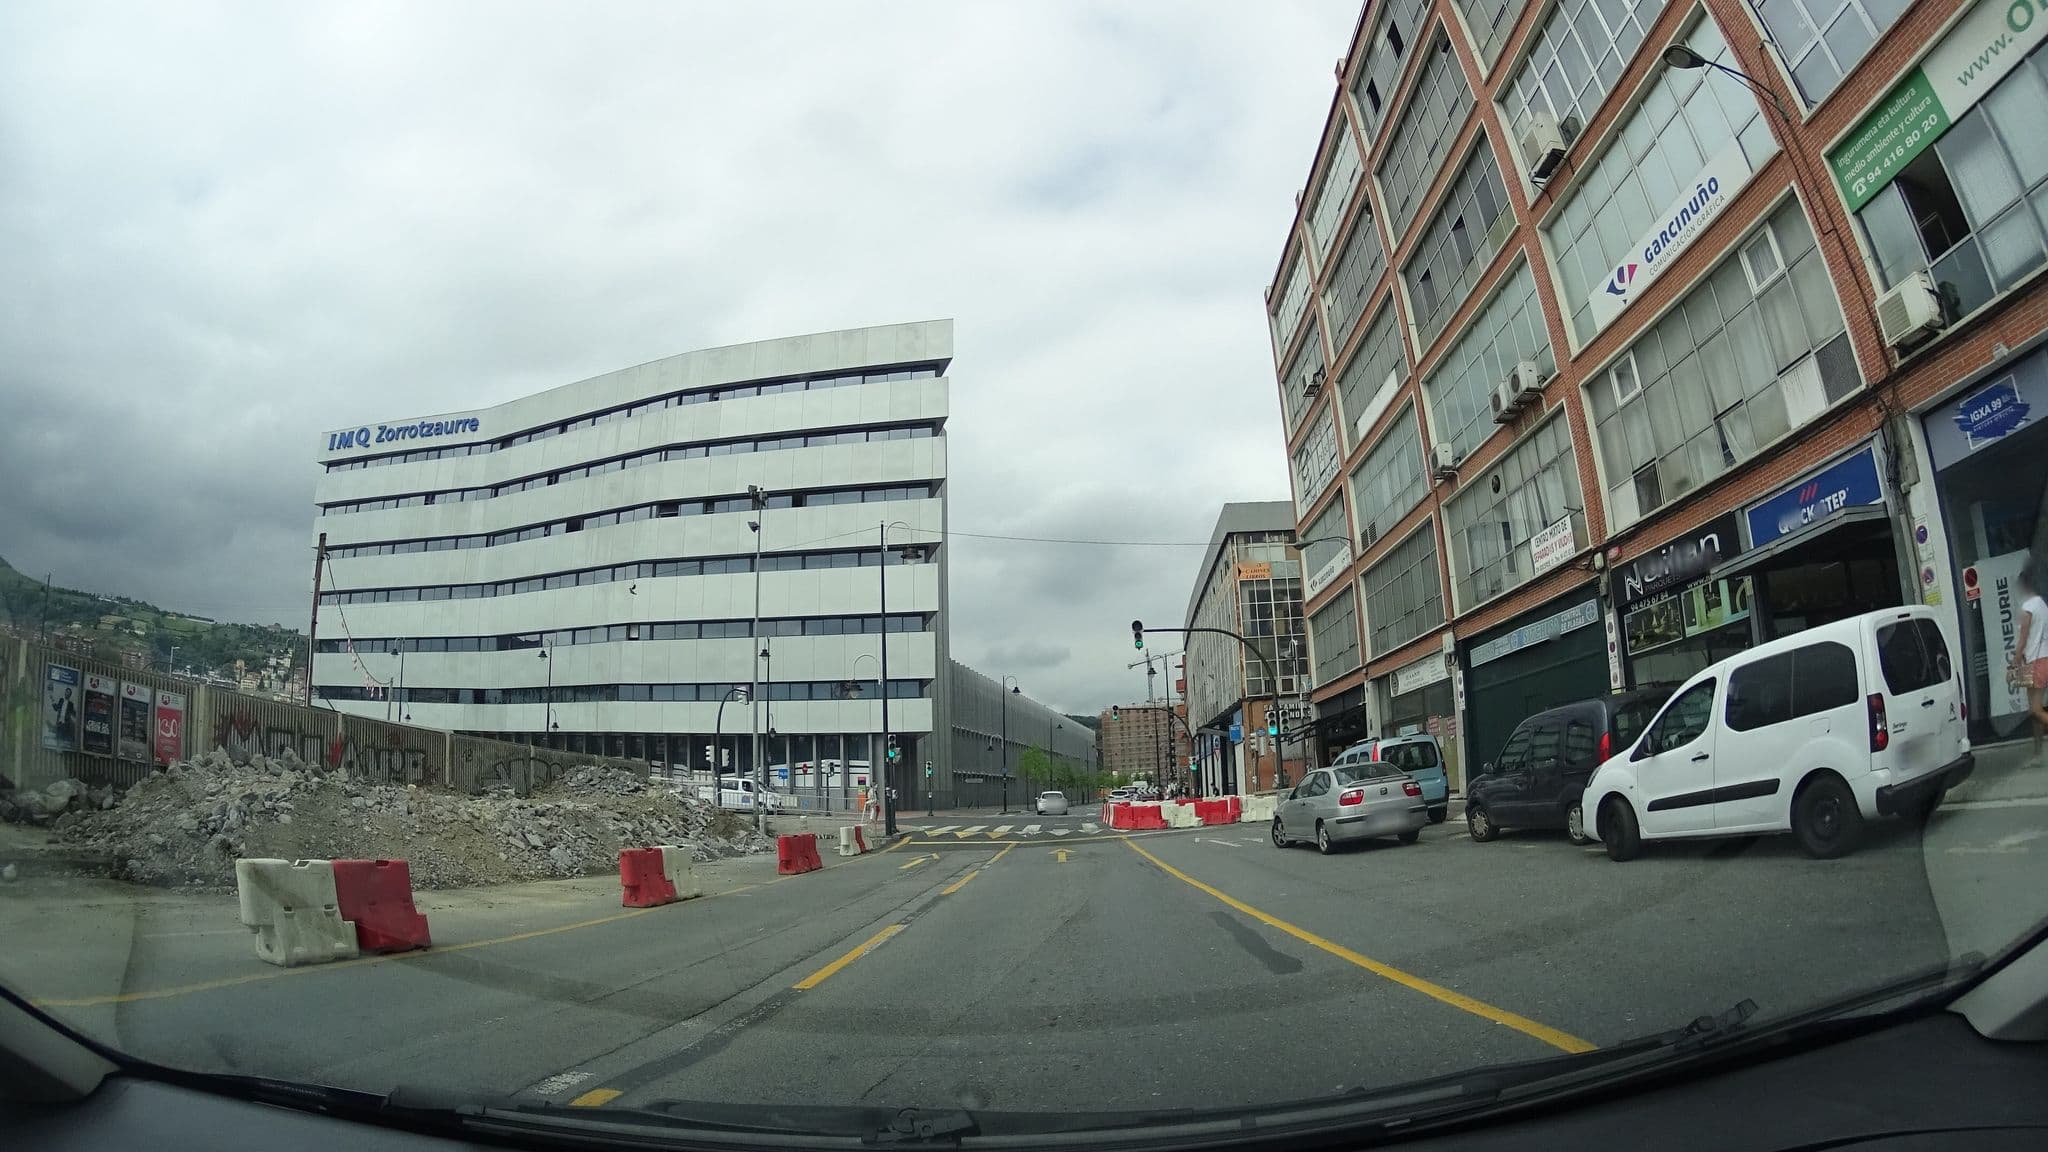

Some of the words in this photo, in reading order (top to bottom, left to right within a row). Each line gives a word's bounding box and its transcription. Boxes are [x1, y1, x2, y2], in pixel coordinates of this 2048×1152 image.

[1837, 123, 1878, 168] Ingurumena
[1878, 112, 1890, 129] eta
[1888, 87, 1917, 118] kultura
[1843, 158, 1866, 183] medio
[1865, 126, 1900, 169] ambiente
[1904, 96, 1932, 127] cultura
[1866, 166, 1882, 184] 94
[1883, 146, 1904, 168] 416
[1905, 130, 1921, 148] 80
[1922, 113, 1938, 132] 20
[1649, 224, 1696, 276] COMUNICACIÓN
[1696, 194, 1726, 227] GRÁFICA
[328, 427, 370, 451] IMQ
[375, 417, 479, 443] Zorrotzaurre
[1970, 404, 1991, 423] IGXA
[1991, 398, 2002, 411] 99
[1561, 608, 1581, 622] CONTROL
